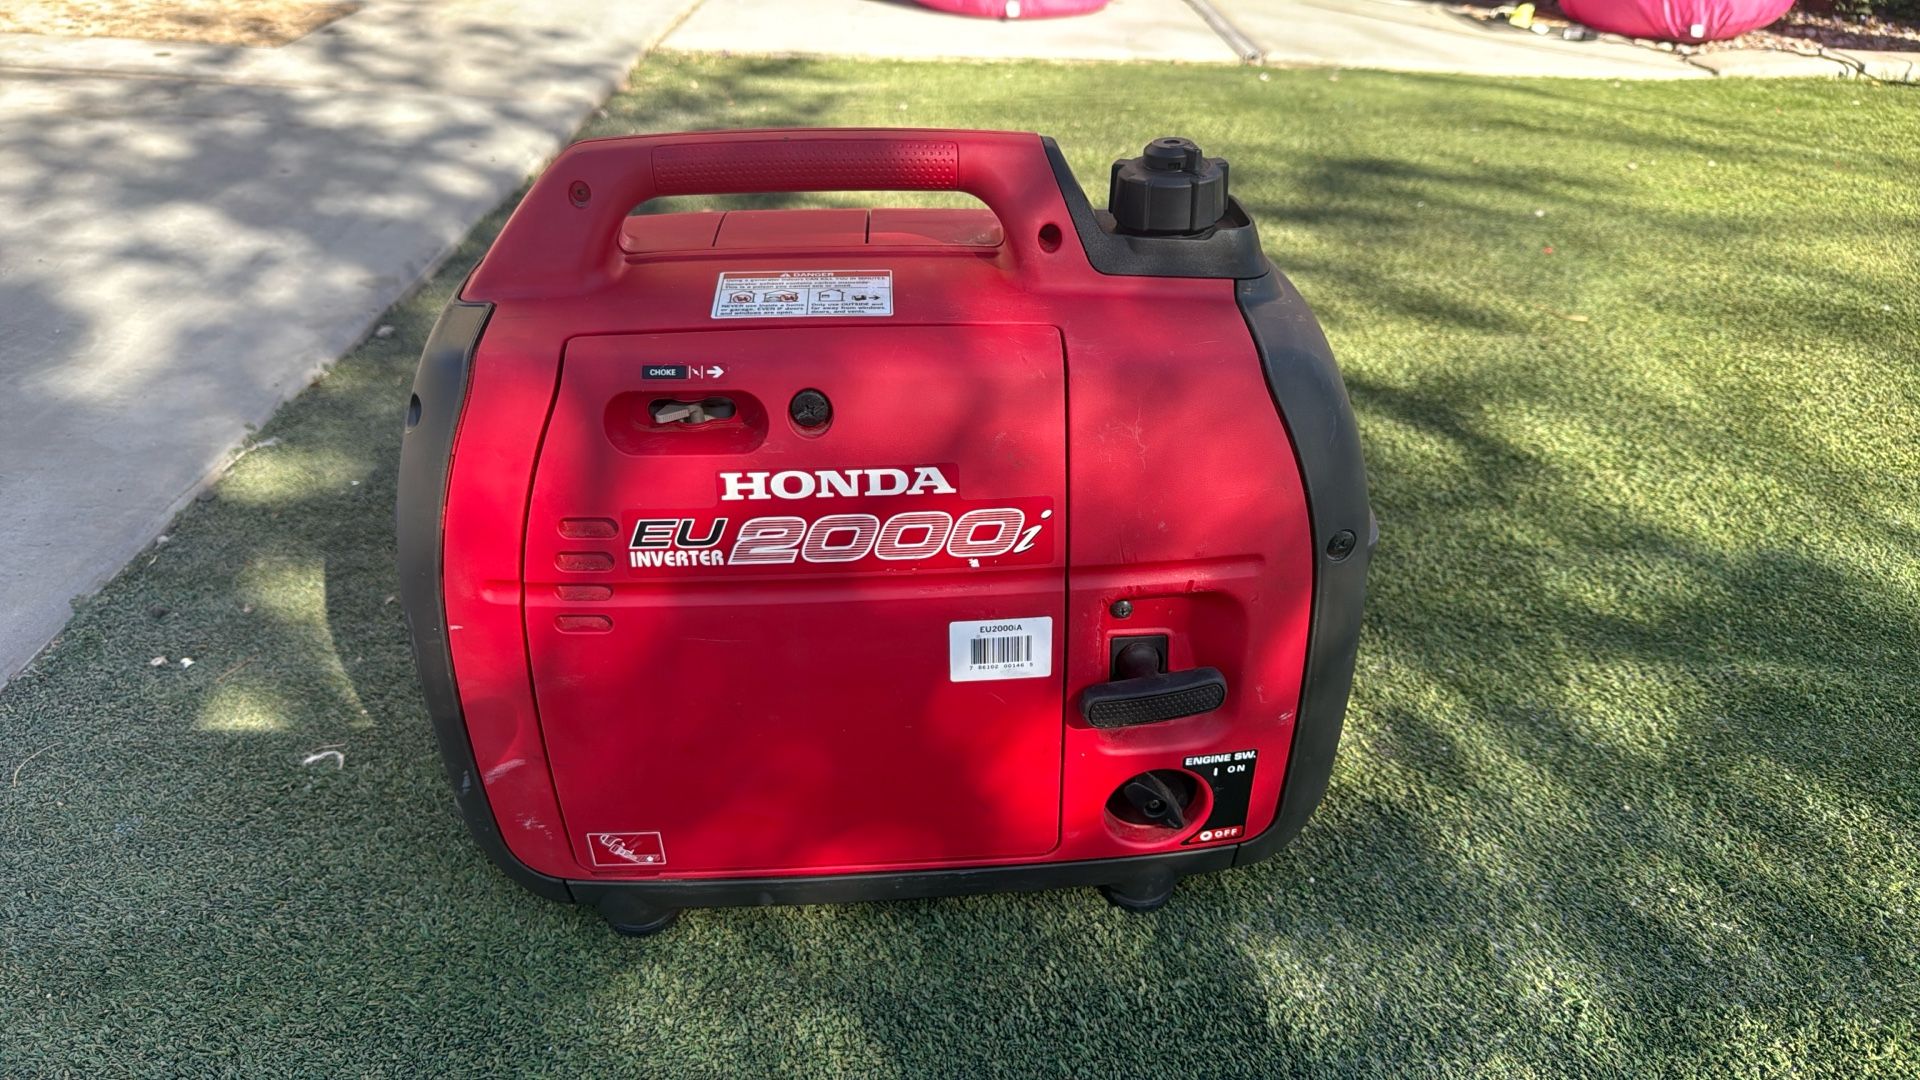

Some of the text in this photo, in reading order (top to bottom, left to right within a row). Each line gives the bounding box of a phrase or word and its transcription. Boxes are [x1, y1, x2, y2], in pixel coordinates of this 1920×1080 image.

[649, 368, 676, 376] CHOKE
[719, 466, 957, 501] HONDA
[629, 549, 725, 568] INVERTER
[980, 624, 1023, 634] EU2000iA
[1185, 750, 1257, 766] ENGINE SW.
[1227, 764, 1246, 774] ON
[1214, 828, 1238, 838] OFF
